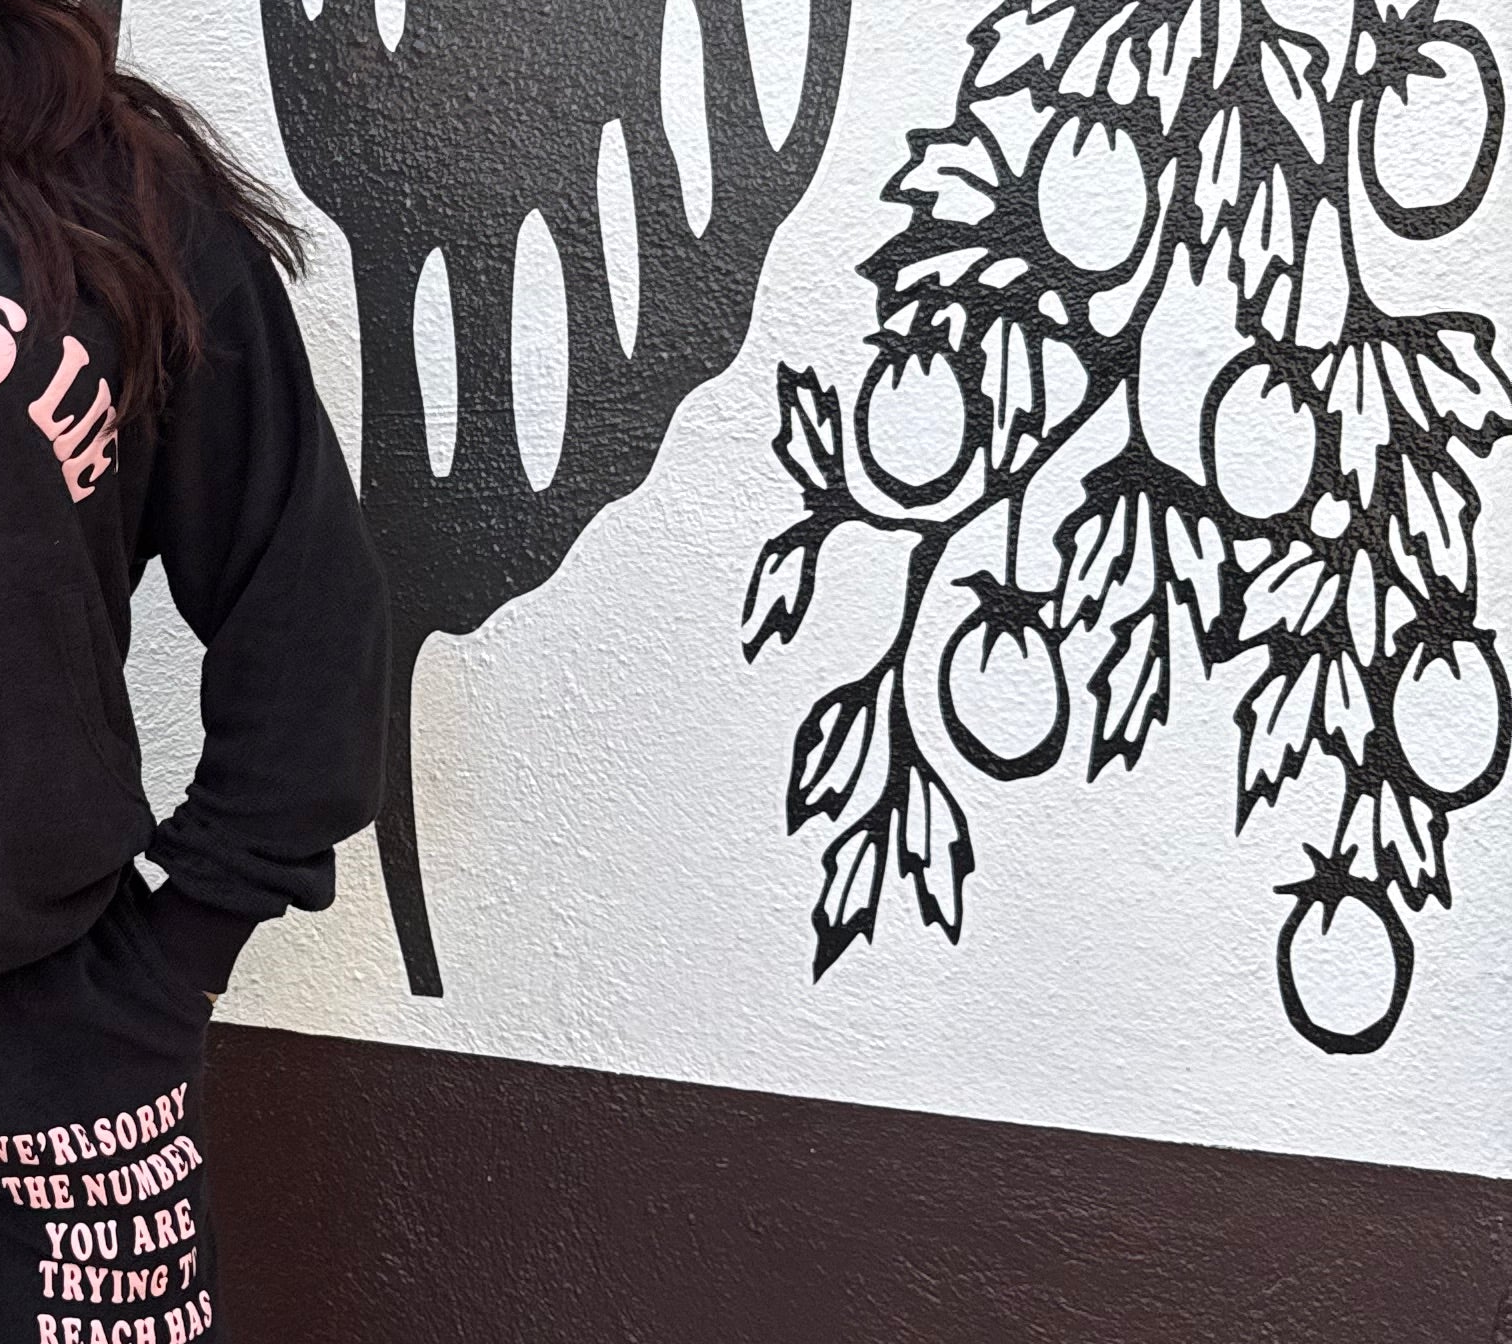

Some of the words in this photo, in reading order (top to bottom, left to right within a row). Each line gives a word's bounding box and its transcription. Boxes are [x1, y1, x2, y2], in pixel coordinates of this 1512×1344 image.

[1, 1174, 75, 1210] THE
[81, 1134, 203, 1207] NUMBER
[45, 1219, 119, 1262] YOU
[132, 1197, 196, 1256] ARE
[38, 1259, 169, 1304] TRYING
[179, 1246, 198, 1290] T
